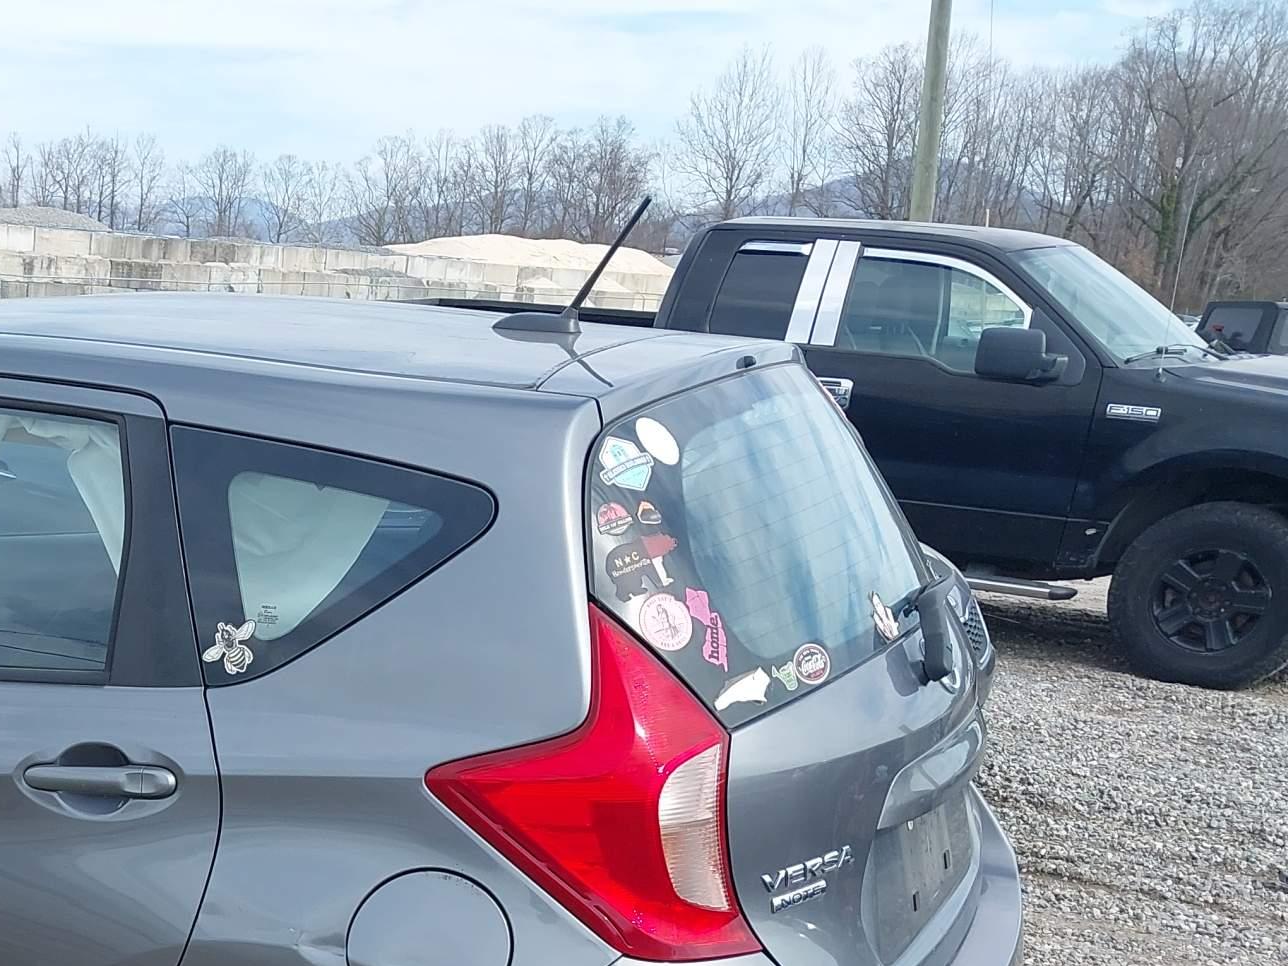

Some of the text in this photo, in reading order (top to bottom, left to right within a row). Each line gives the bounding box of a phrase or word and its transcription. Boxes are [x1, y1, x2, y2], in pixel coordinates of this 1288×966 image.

[708, 615, 719, 661] home
[761, 845, 855, 893] VERSA
[780, 884, 826, 908] NOTE
